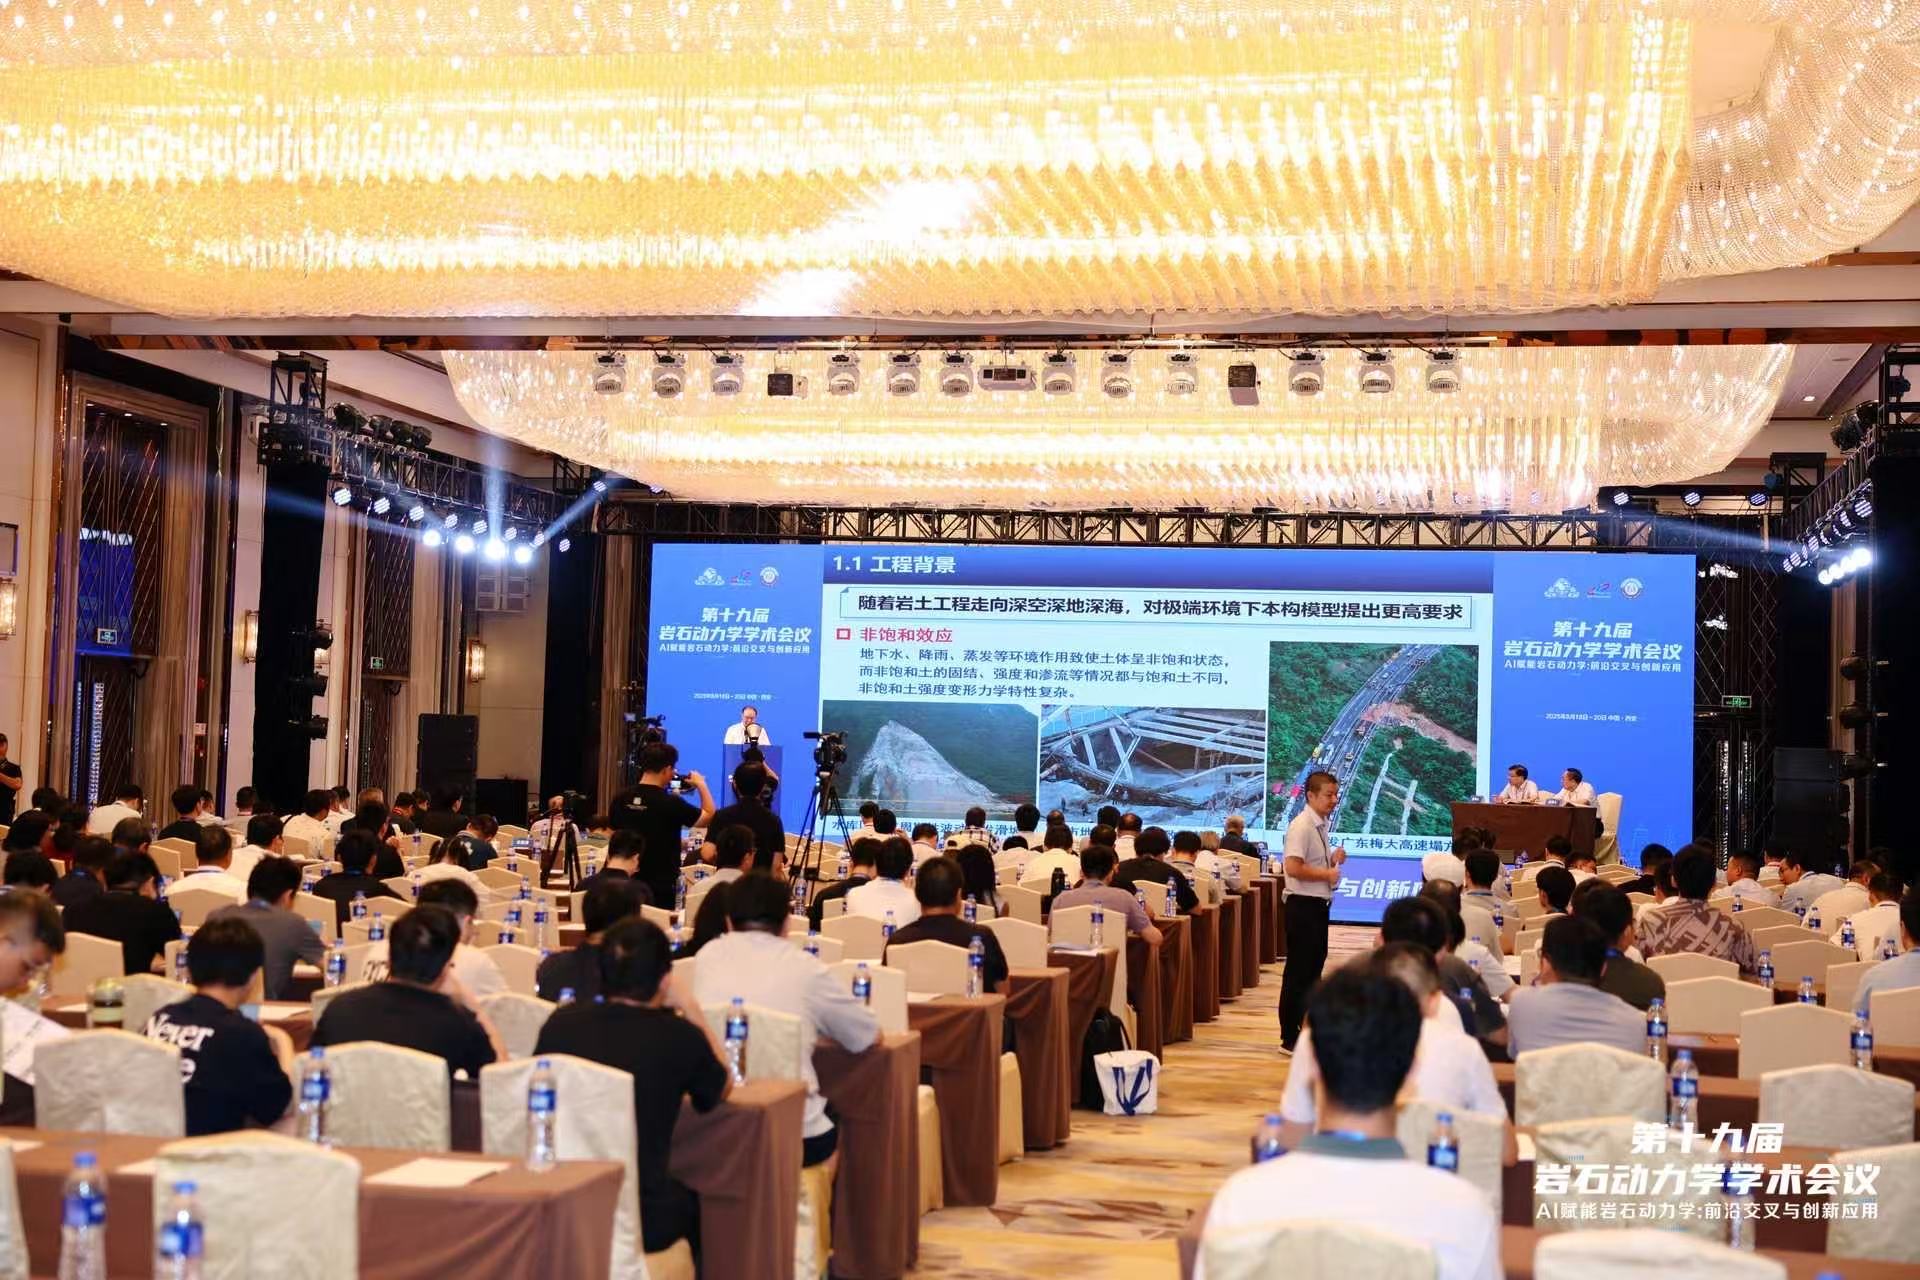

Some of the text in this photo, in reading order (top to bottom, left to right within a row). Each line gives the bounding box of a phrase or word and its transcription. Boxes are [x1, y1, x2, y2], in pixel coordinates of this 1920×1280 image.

[833, 556, 956, 574] 1.1 工程背景
[701, 607, 770, 623] 第十九届
[659, 625, 812, 643] 岩石动力学学术会议
[860, 627, 953, 643] 非饱和效应
[1552, 620, 1633, 638] 第十九届
[1503, 640, 1683, 660] 岩石动力学学术会议
